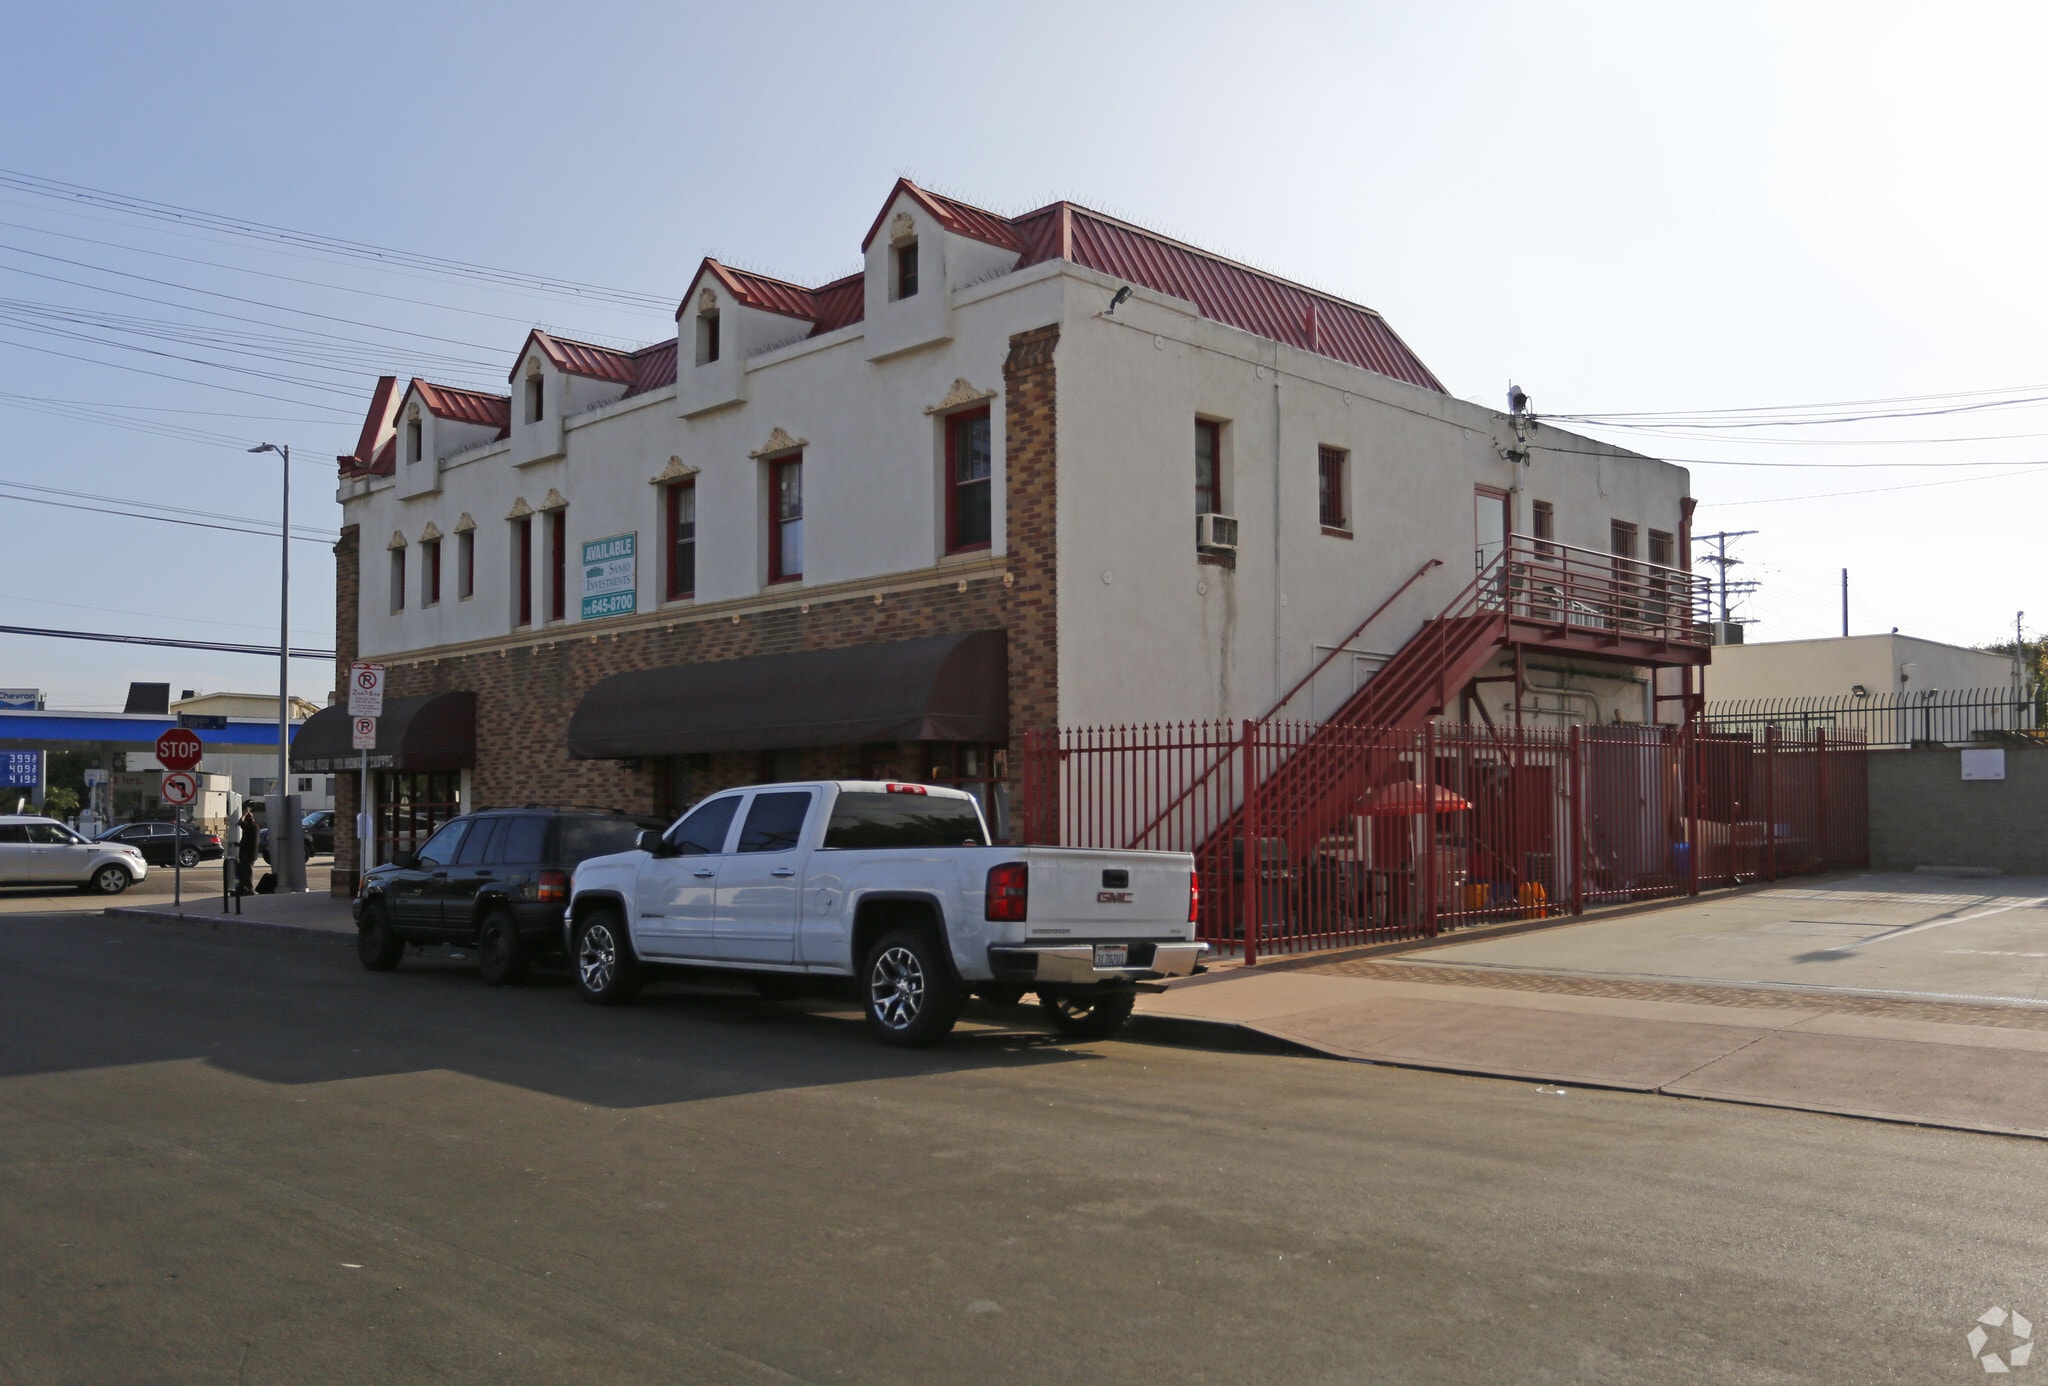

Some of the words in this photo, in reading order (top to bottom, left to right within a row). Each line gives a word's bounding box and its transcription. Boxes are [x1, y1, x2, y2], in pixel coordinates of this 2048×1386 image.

[586, 538, 632, 562] AVAILABLE
[587, 575, 631, 591] INVESTMENTS
[592, 594, 633, 613] 645-8700
[0, 692, 36, 700] Chevron
[160, 741, 200, 758] STOP
[1096, 891, 1133, 904] GMC
